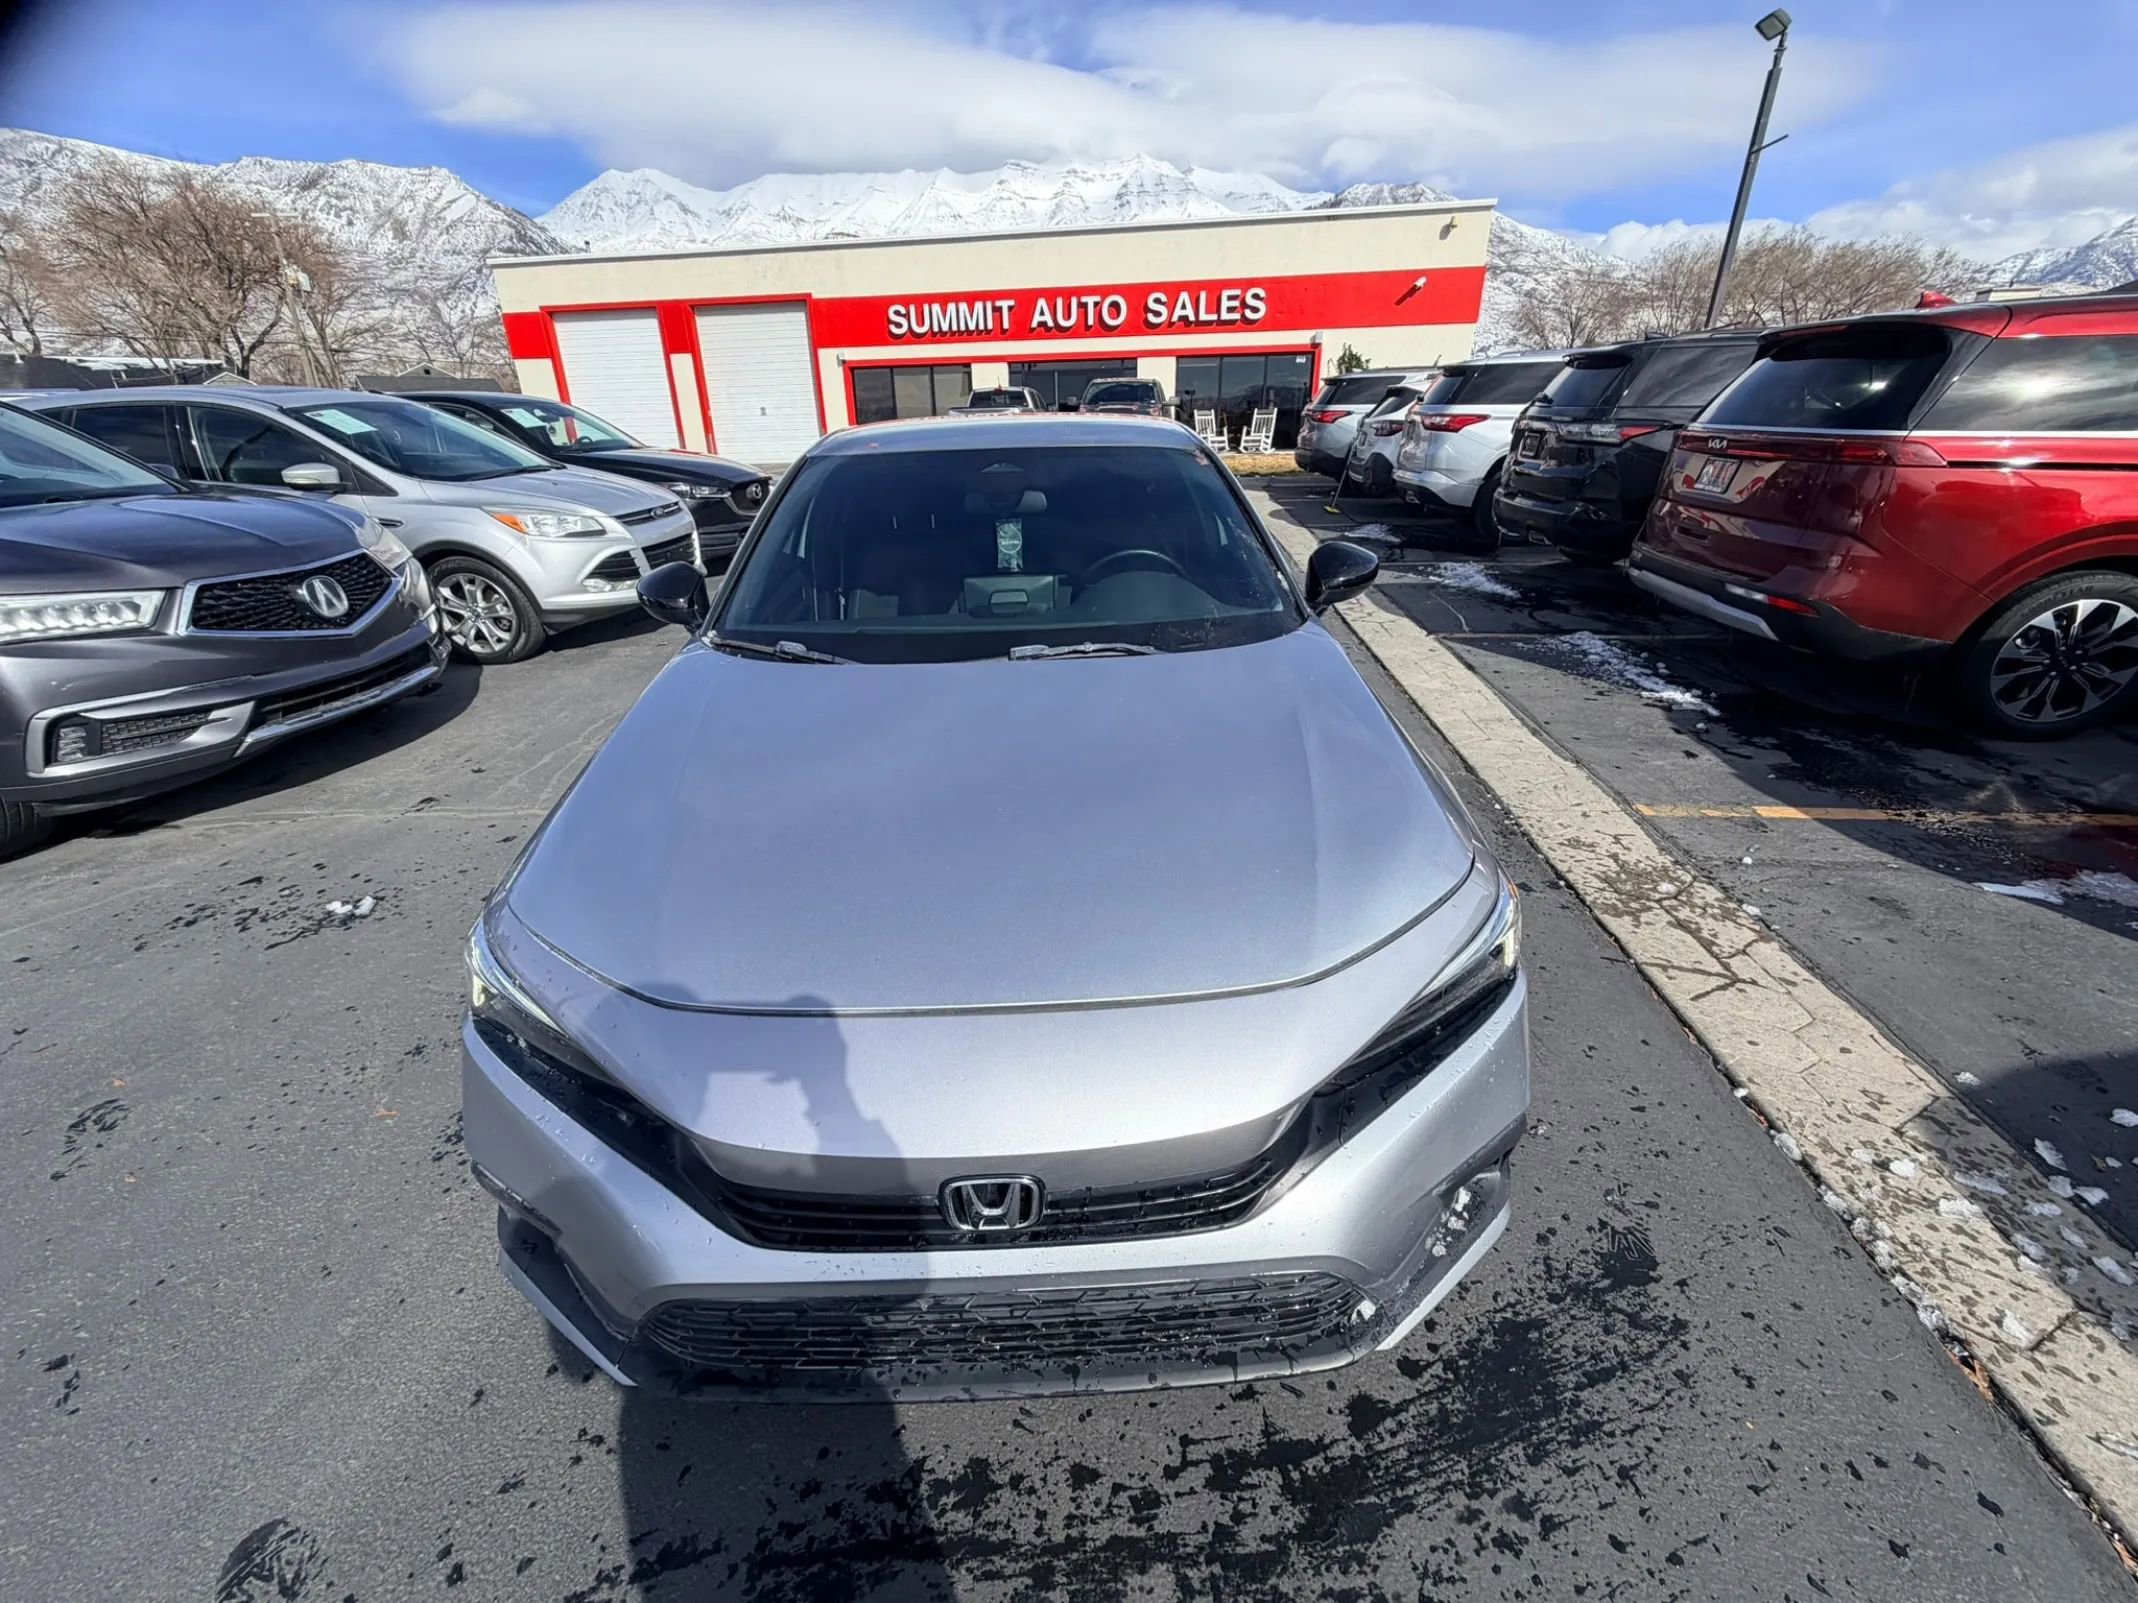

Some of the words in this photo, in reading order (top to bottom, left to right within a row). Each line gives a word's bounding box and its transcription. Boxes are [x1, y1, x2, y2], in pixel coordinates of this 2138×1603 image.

[887, 299, 1015, 335] SUMMIT
[1030, 294, 1127, 328] AUTO
[1146, 287, 1267, 325] SALES
